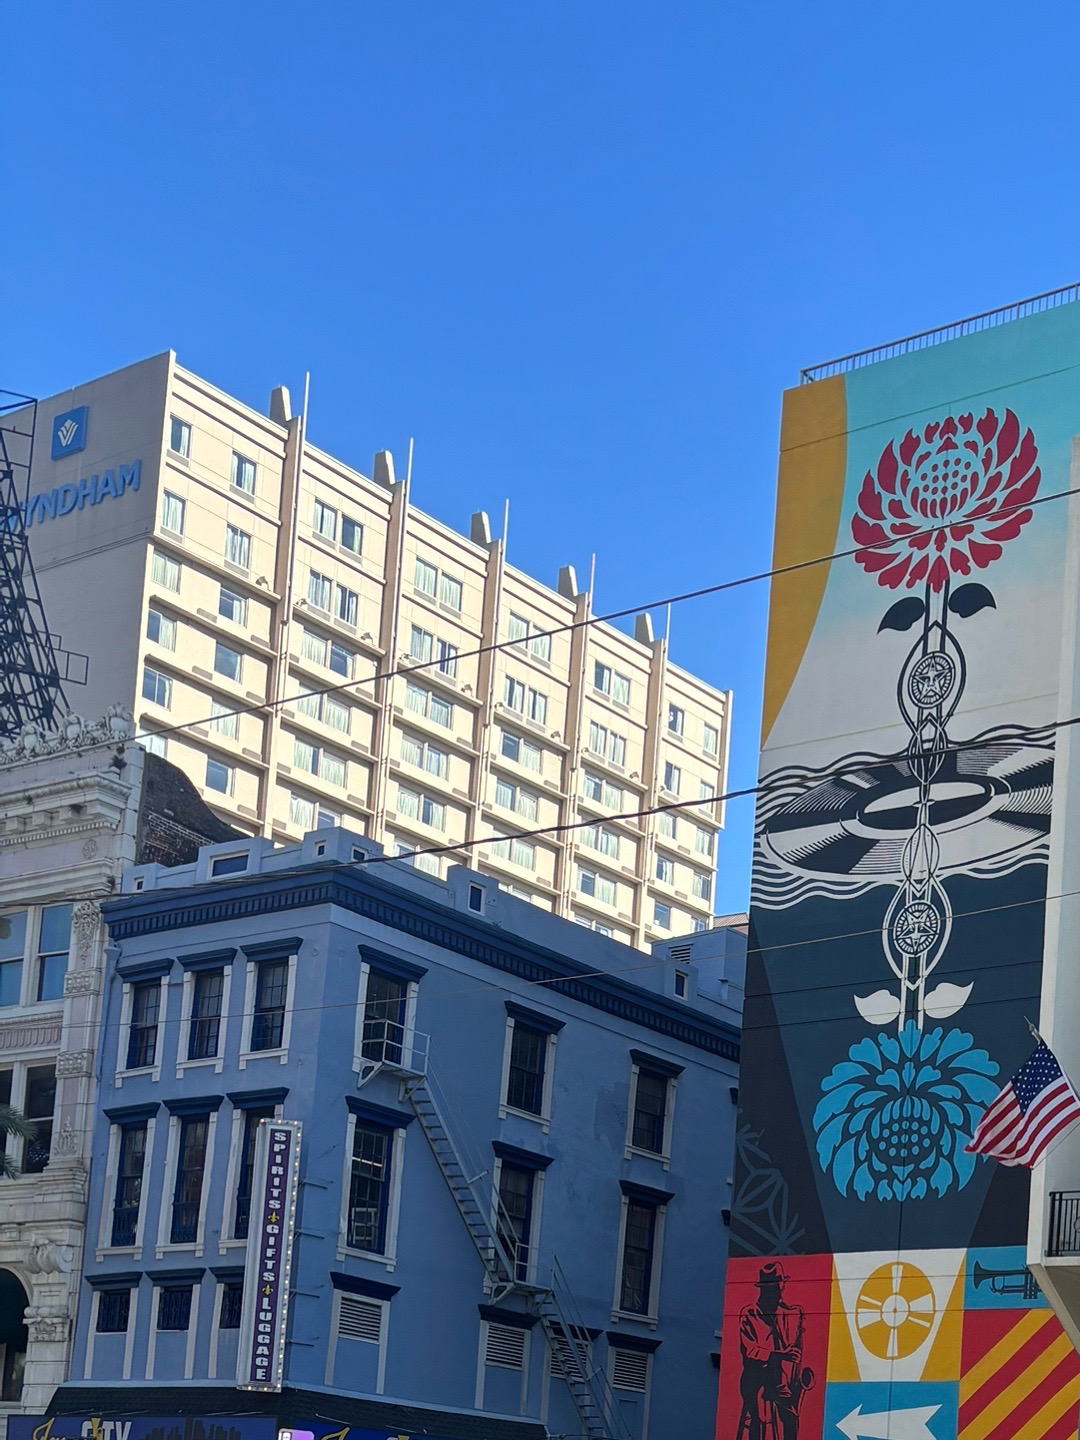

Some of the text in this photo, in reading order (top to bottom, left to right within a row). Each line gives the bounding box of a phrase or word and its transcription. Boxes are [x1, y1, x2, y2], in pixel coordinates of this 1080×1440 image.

[0, 459, 142, 533] YNDHAM
[255, 1131, 287, 1381] SPIRITS GIFTS LUGGAGE
